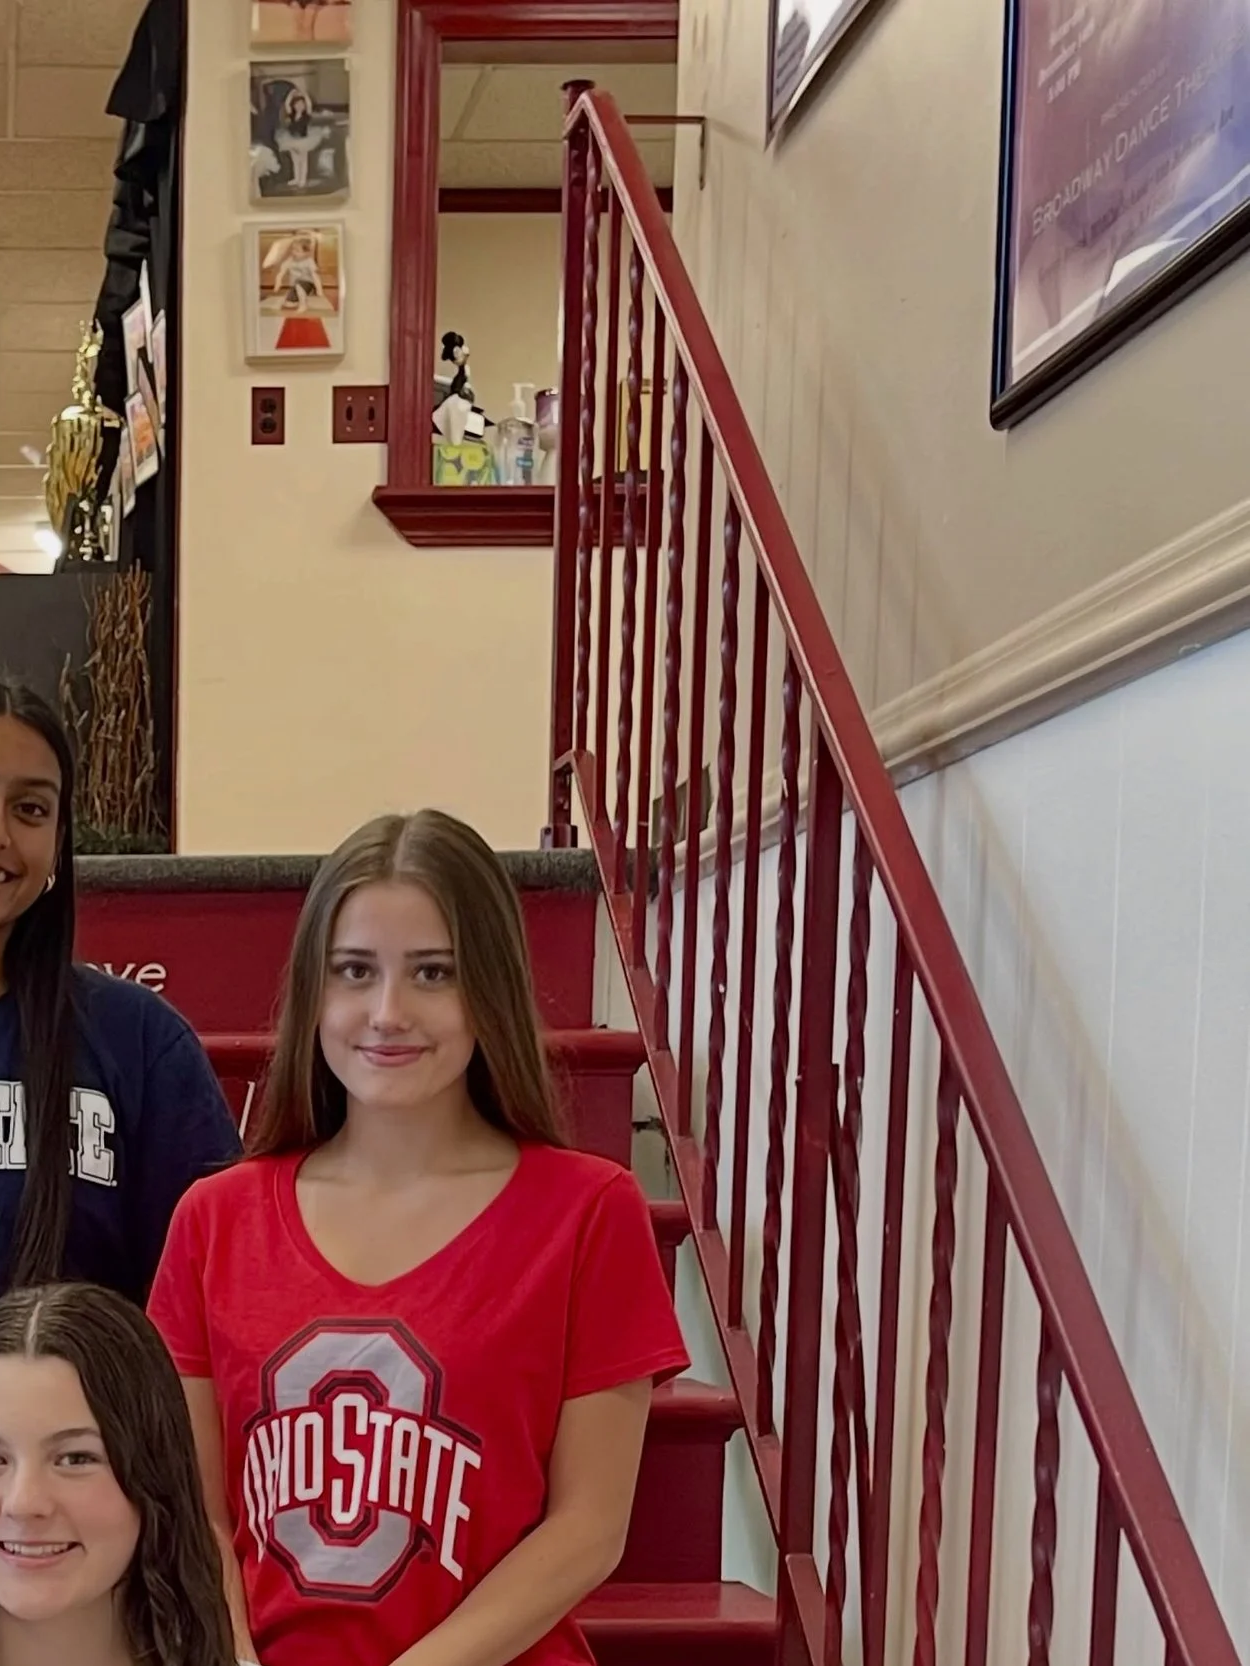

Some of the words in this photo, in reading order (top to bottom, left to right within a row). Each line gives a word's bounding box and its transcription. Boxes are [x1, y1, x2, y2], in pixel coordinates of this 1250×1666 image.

[1031, 146, 1113, 238] BROADWAY
[1114, 93, 1171, 164] DANCE
[330, 1392, 482, 1582] STATE
